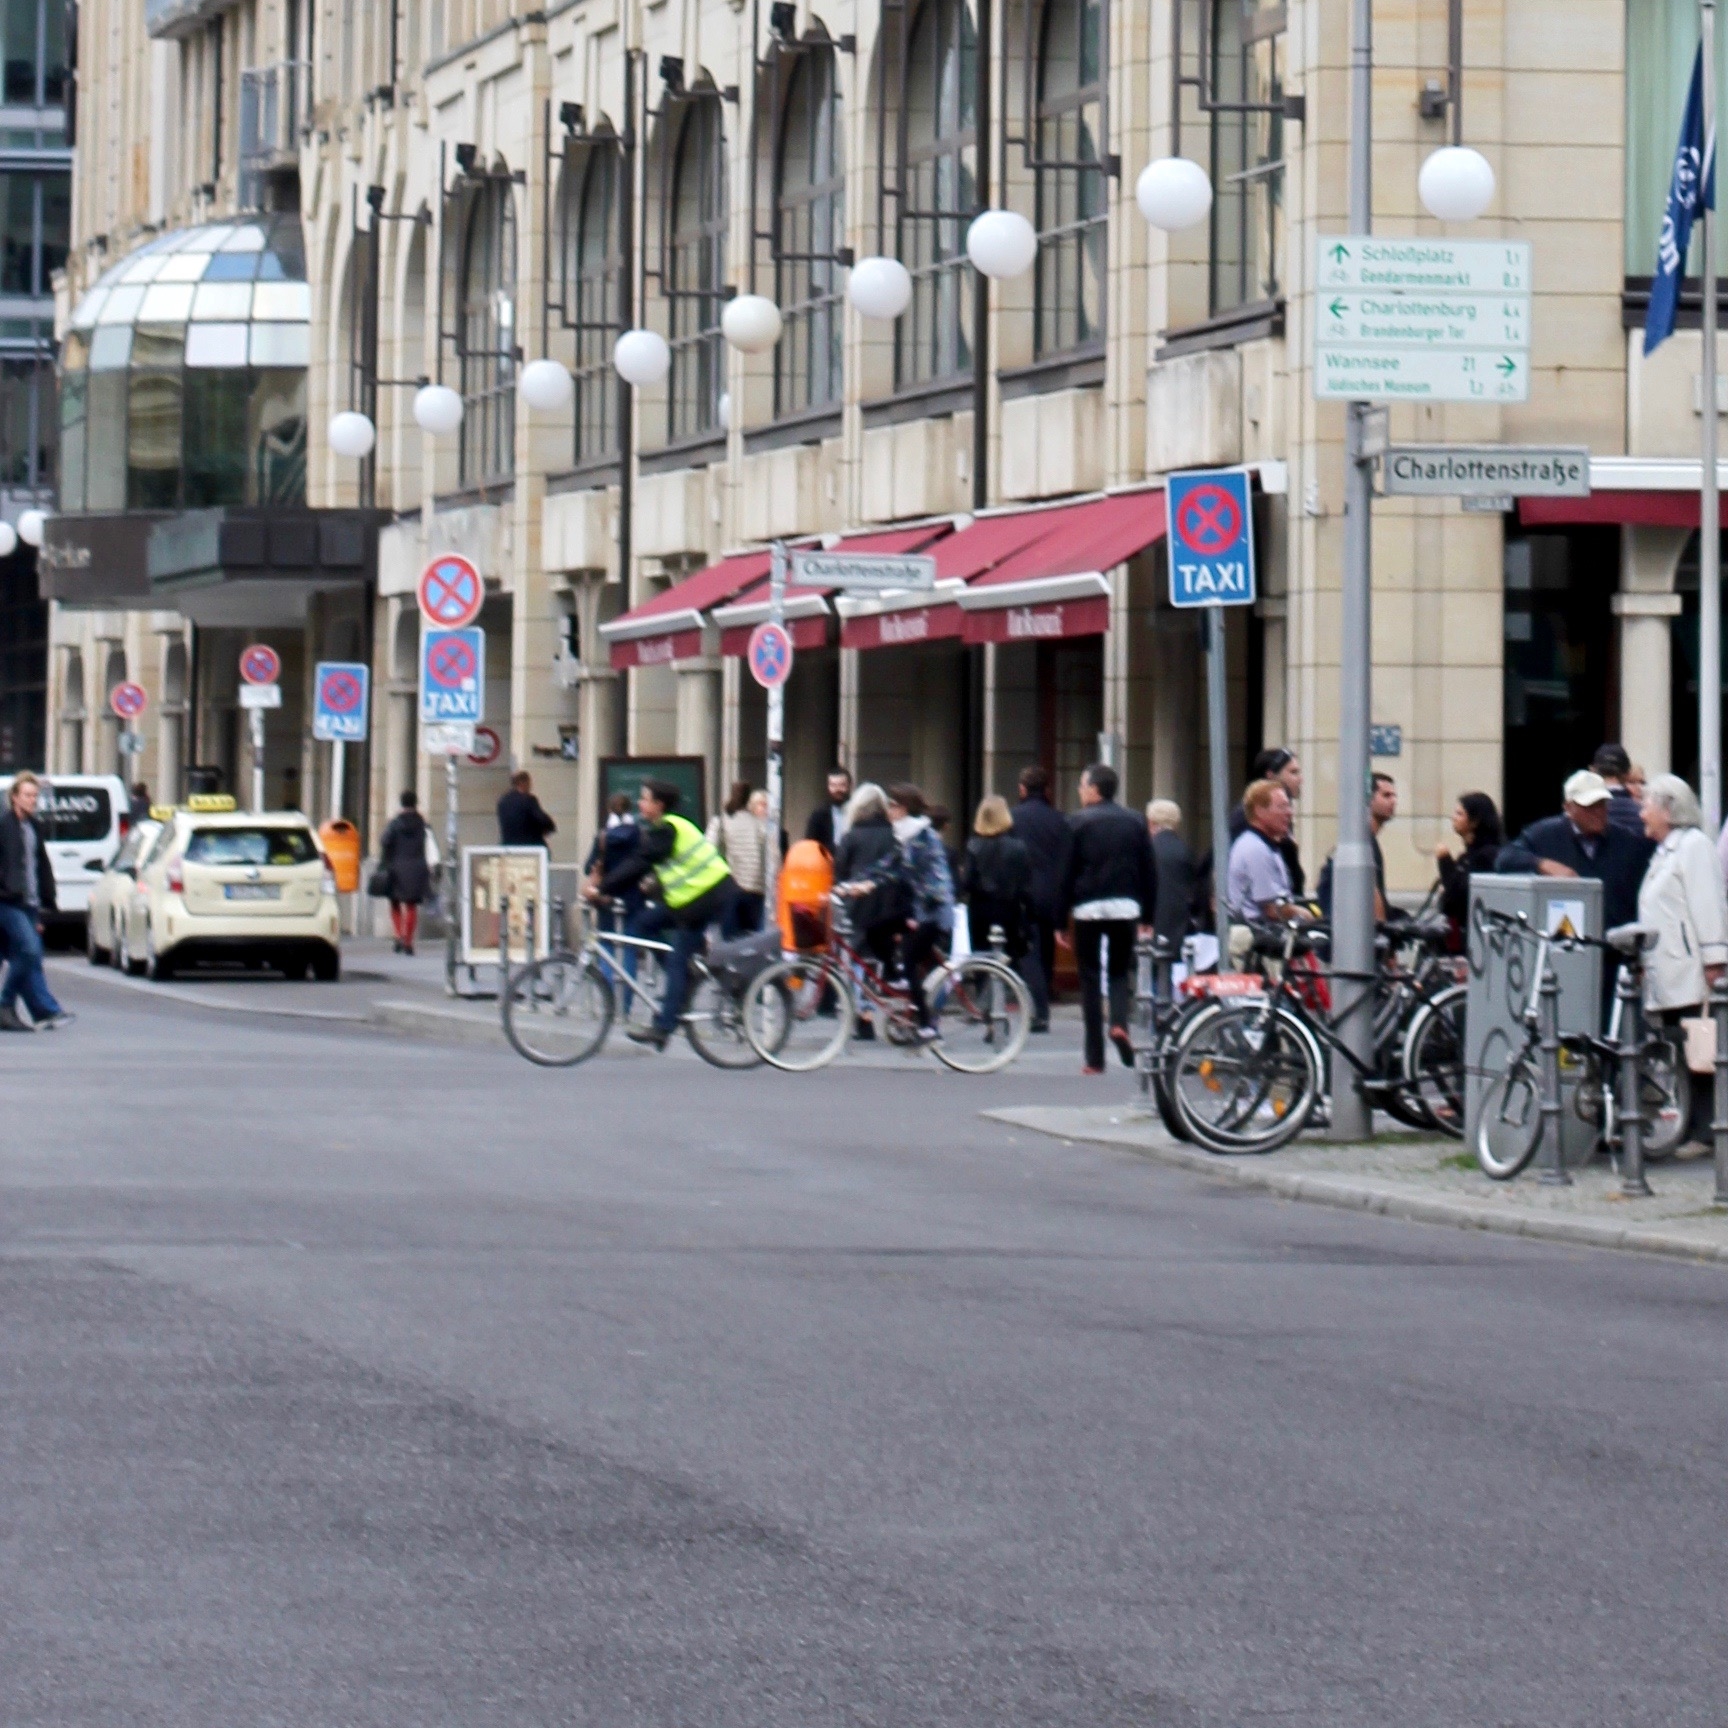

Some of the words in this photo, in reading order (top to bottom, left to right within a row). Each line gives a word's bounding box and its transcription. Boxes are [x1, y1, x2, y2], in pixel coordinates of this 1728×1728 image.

[1360, 299, 1476, 321] Charlottenburg
[1326, 354, 1399, 369] Wannsee
[1394, 455, 1579, 486] Charlottenstraße
[1178, 562, 1245, 593] TAXI
[426, 693, 476, 717] TAXI
